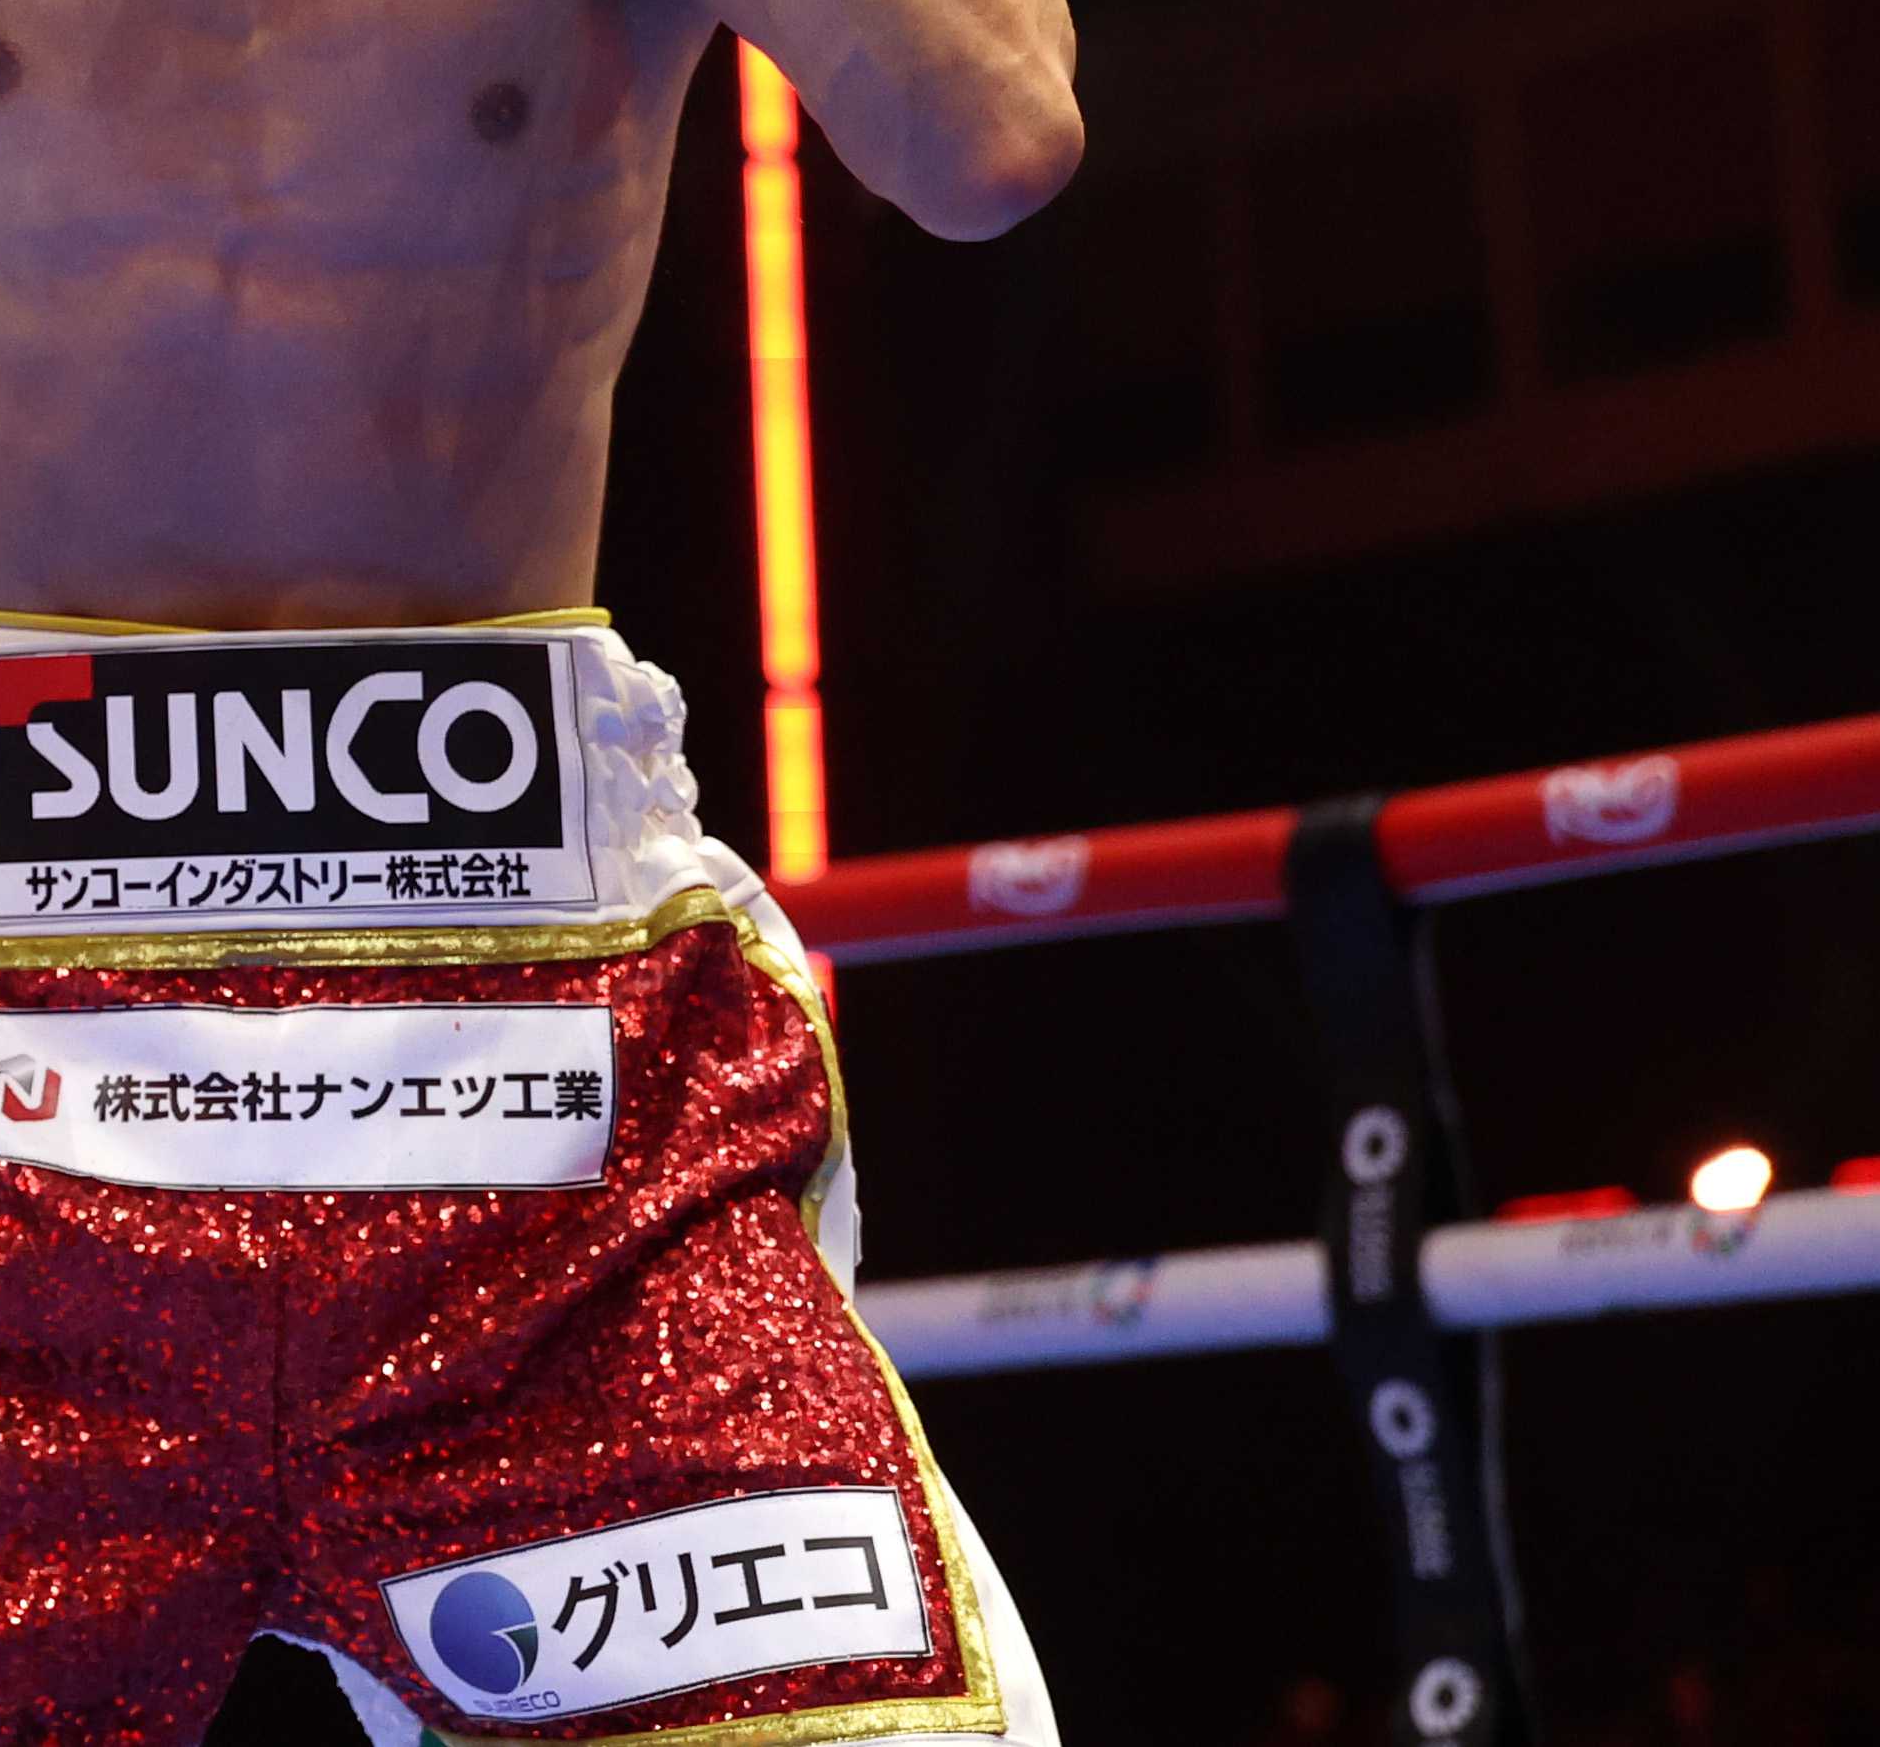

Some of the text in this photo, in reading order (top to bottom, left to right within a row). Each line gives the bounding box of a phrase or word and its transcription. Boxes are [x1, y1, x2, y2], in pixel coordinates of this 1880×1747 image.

[24, 669, 539, 825] SUNCO
[25, 854, 532, 912] サンコーインダストリー株式会社
[93, 1069, 603, 1123] 株式会社ナンエツ工業
[551, 1535, 890, 1672] グリエコ
